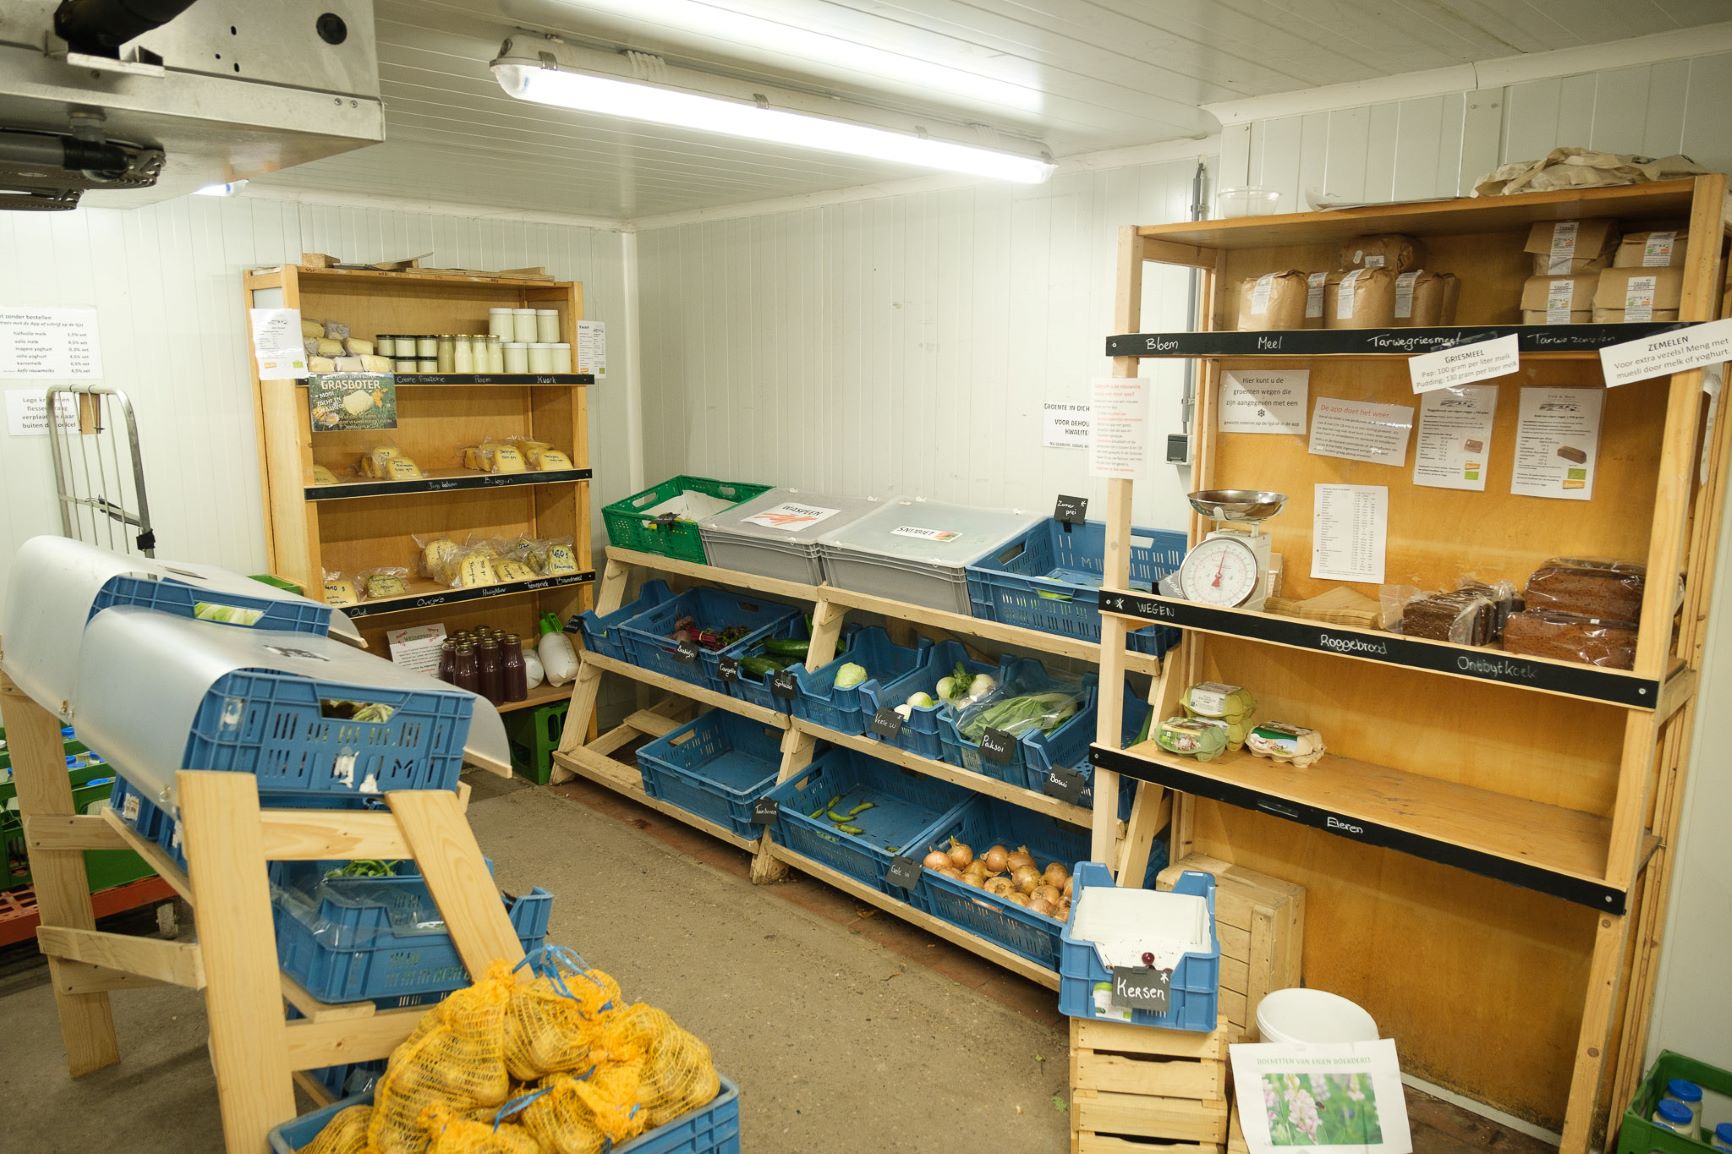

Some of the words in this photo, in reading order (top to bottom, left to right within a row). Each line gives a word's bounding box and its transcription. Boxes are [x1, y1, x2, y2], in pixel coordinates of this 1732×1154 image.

[1257, 336, 1283, 349] Meel
[1648, 336, 1689, 352] ZEMELEN
[1445, 350, 1485, 363] GRIESMEEL
[1614, 361, 1633, 370] Voor
[1635, 355, 1656, 366] extra
[1686, 343, 1711, 353] Meng
[1712, 338, 1729, 347] met
[1437, 367, 1450, 375] 100
[1451, 364, 1467, 373] gram
[1468, 361, 1479, 370] per
[1480, 357, 1494, 367] liter
[1459, 371, 1475, 380] gram
[1477, 368, 1487, 377] per
[1488, 365, 1502, 374] liter
[1616, 368, 1642, 379] muesli
[1643, 364, 1662, 373] door
[1664, 359, 1685, 368] melk
[1685, 356, 1694, 364] of
[321, 380, 381, 390] GRASBOTER
[1071, 419, 1090, 427] BEHOU
[1136, 601, 1175, 617] WEGEN
[1320, 634, 1388, 655] Roggebrood
[982, 734, 1005, 753] Paksoi
